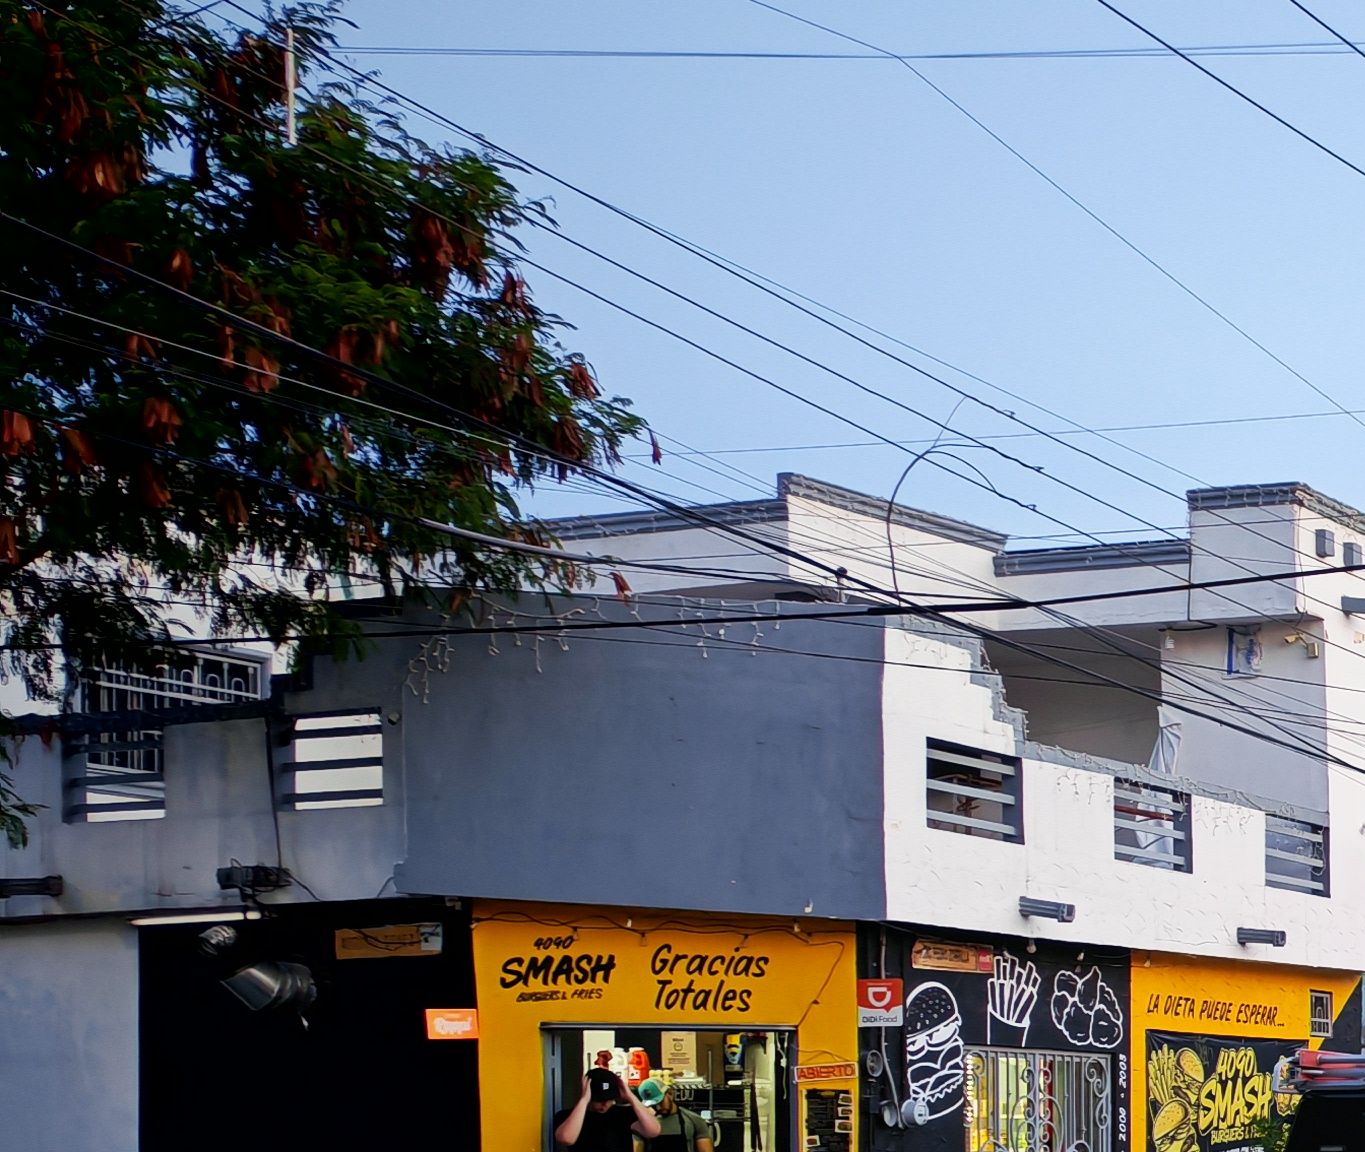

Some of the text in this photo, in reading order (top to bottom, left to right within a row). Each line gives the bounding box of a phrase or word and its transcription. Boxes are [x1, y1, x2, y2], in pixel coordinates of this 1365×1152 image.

[499, 953, 616, 988] SMASH
[651, 943, 770, 978] Gracias
[654, 979, 753, 1013] Totales
[1147, 993, 1285, 1027] LA DIETA PUEDE ESPERAR...
[797, 1065, 855, 1080] ABIERTO
[1217, 1048, 1257, 1080] 4090
[1200, 1072, 1273, 1130] SMASH
[1119, 1107, 1127, 1142] 2000
